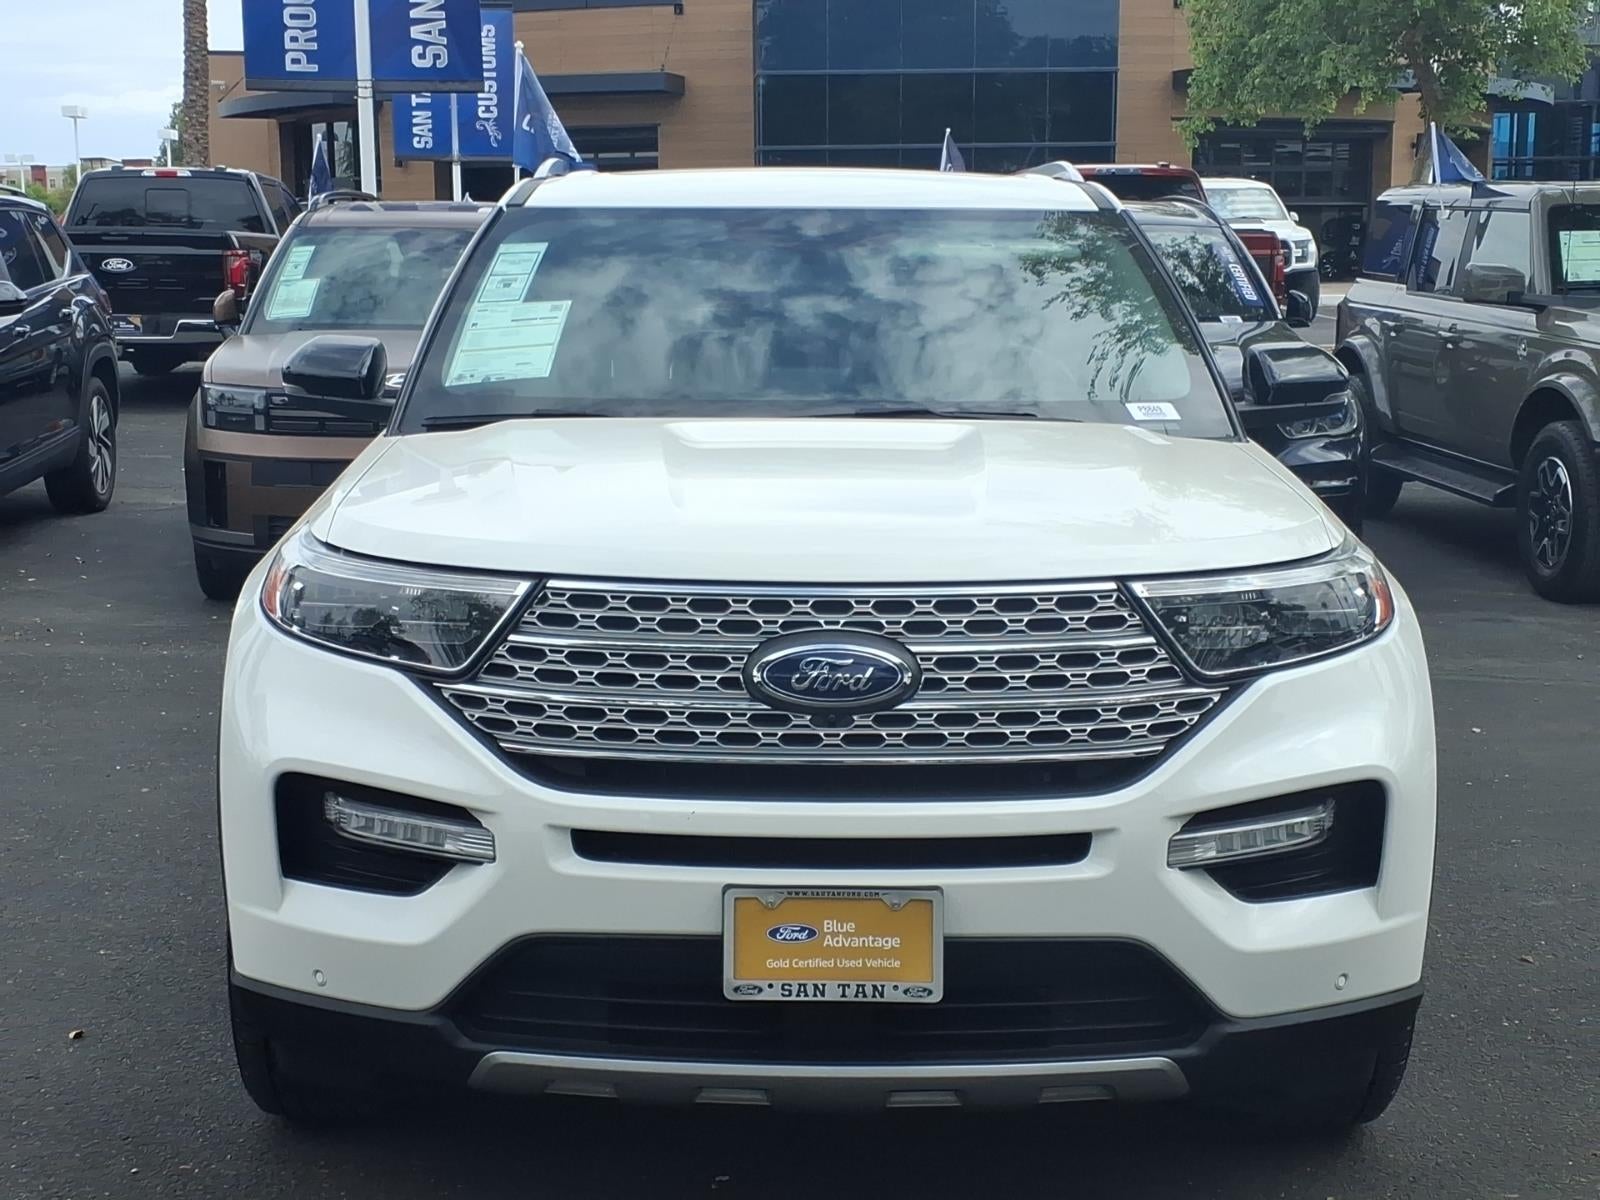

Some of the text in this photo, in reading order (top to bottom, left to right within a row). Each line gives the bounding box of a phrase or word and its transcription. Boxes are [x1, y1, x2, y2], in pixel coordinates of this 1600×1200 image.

[283, 0, 318, 72] PRO
[409, 0, 448, 68] SAN
[411, 92, 433, 149] SAN T
[1228, 264, 1257, 300] CERTIFIED
[791, 657, 874, 692] Ford
[776, 926, 810, 941] Ford
[823, 920, 856, 932] Blue
[823, 935, 901, 949] Advantage
[766, 958, 901, 968] Gold Certified Used Vehicle
[781, 983, 886, 998] SAN TAN
